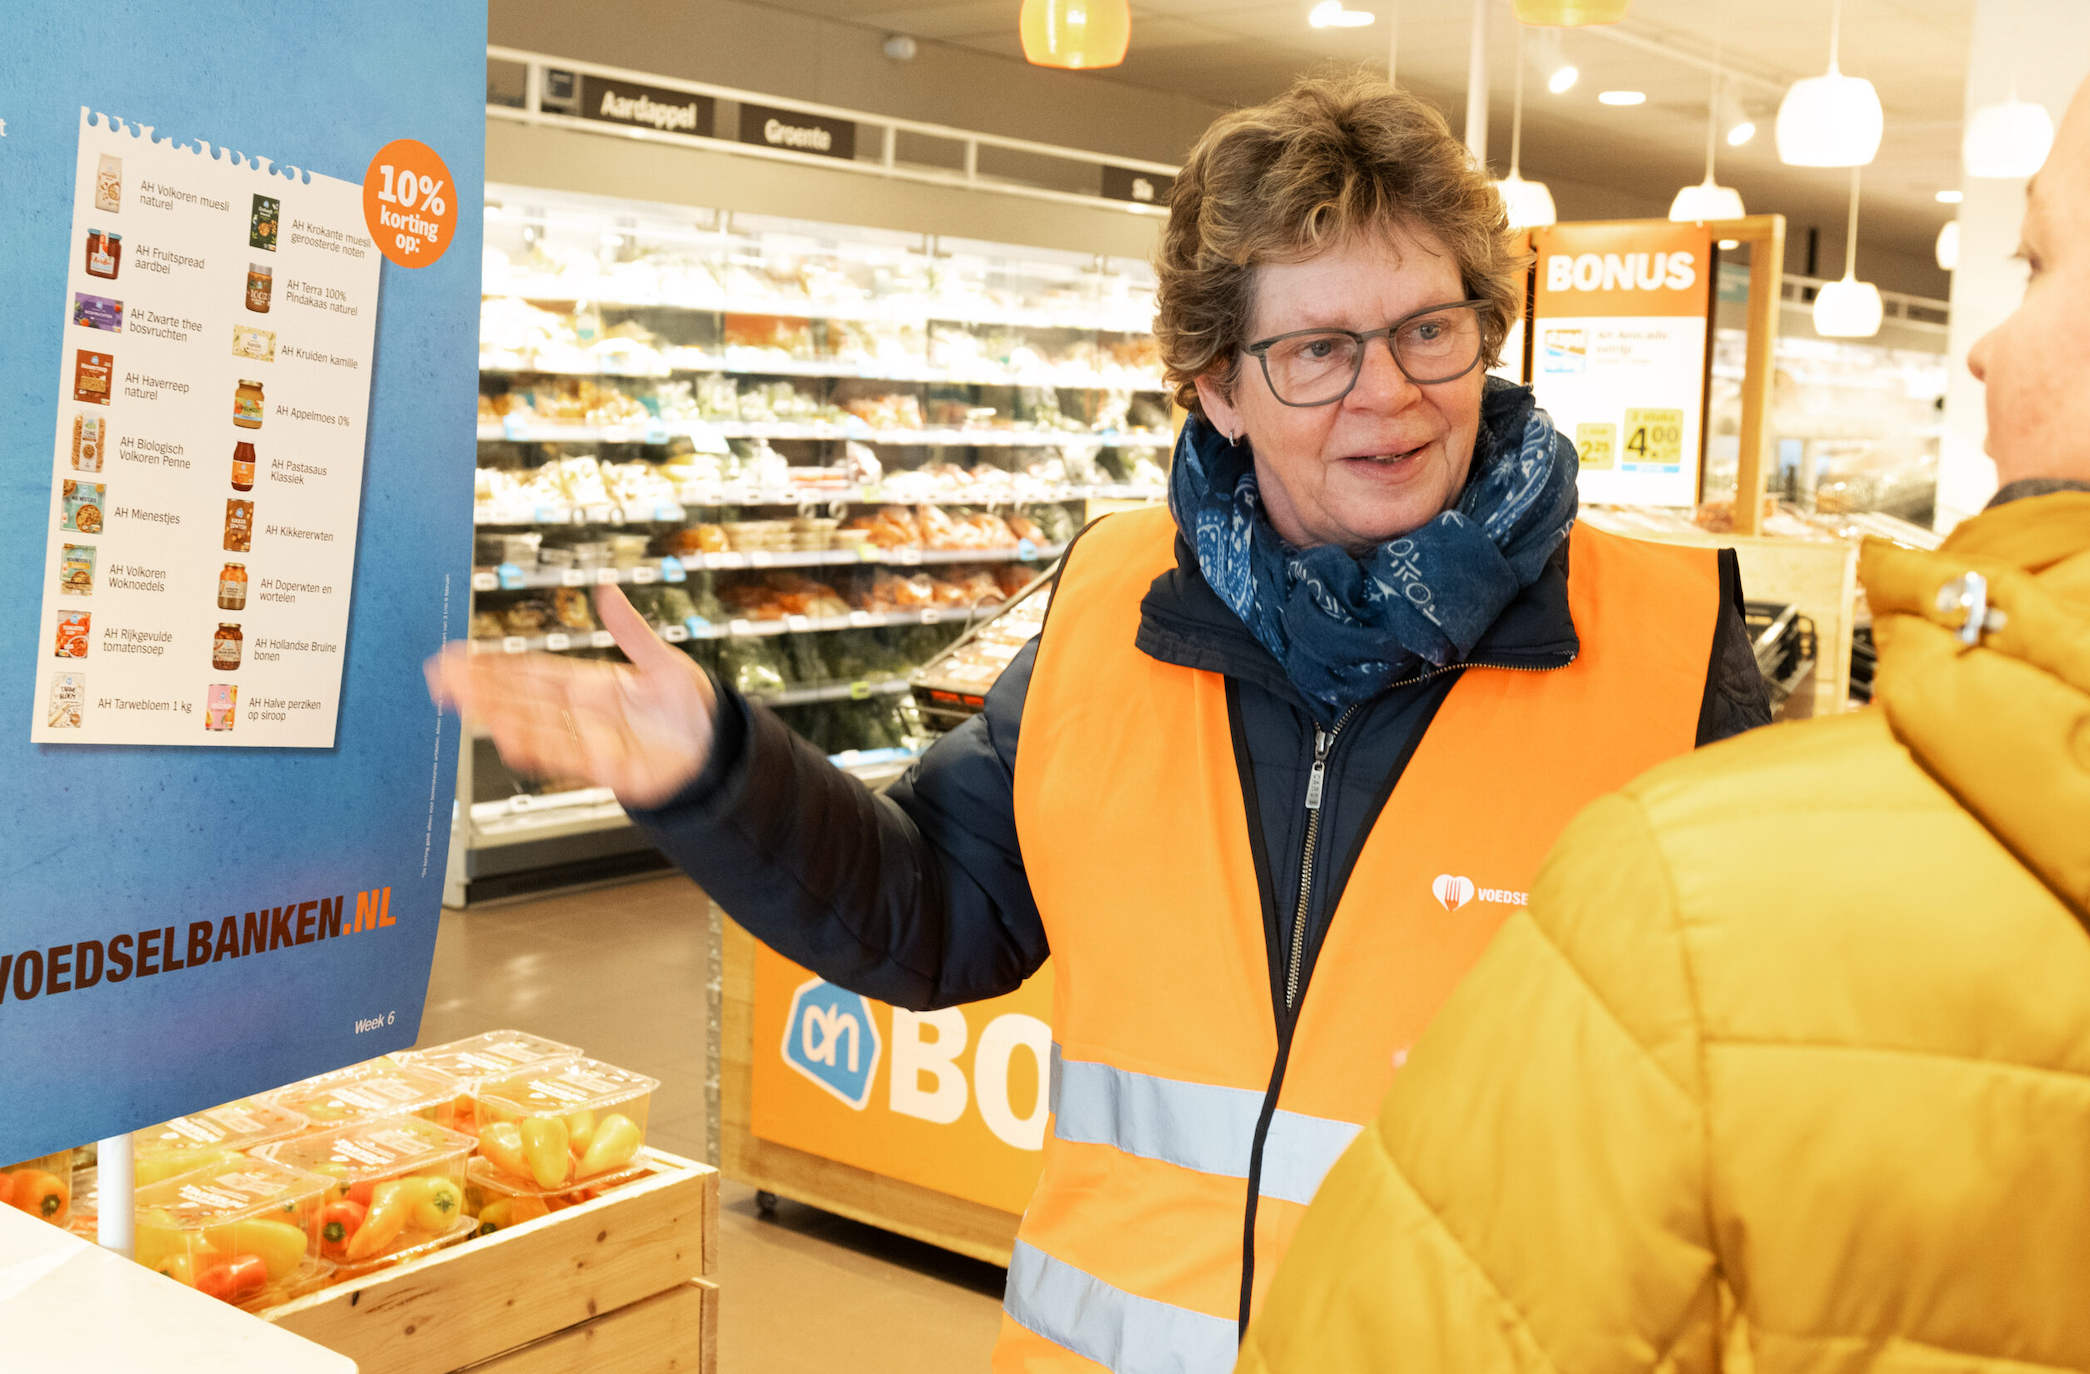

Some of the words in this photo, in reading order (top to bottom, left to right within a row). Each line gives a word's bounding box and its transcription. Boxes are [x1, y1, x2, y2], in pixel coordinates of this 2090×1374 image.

[600, 90, 697, 131] Aardappel
[764, 118, 832, 151] Groente
[141, 181, 154, 192] AH
[157, 184, 197, 204] Volkoren
[200, 196, 230, 212] muesli
[378, 165, 445, 216] 10%
[140, 195, 173, 211] naturel
[380, 204, 438, 242] korting
[292, 219, 304, 230] AH
[307, 223, 343, 242] Krokante
[346, 233, 371, 248] muesli
[291, 232, 340, 252] geroosterde
[342, 246, 365, 259] noten
[396, 234, 420, 254] op:
[136, 244, 150, 256] AH
[153, 248, 204, 269] Fruitspread
[135, 259, 170, 274] aardbei
[1547, 252, 1696, 292] BONUS
[287, 279, 299, 290] AH
[302, 282, 322, 296] Terra
[326, 288, 346, 301] 100%
[286, 291, 327, 310] Pindakaas
[330, 301, 357, 316] naturel
[131, 308, 144, 320] AH
[148, 312, 179, 327] Zwarte
[182, 318, 202, 332] thee
[130, 321, 187, 342] bosvruchten
[282, 345, 293, 356] AH
[296, 348, 327, 363] Kruiden
[330, 354, 358, 369] kamille
[126, 372, 138, 383] AH
[142, 375, 189, 394] Haverreep
[124, 386, 157, 400] naturel
[276, 405, 288, 416] AH
[291, 408, 335, 425] Appelmoes
[338, 416, 350, 426] 0%
[120, 436, 134, 447] AH
[138, 439, 184, 455] Biologisch
[120, 450, 159, 464] Volkoren
[163, 456, 191, 469] Penne
[272, 458, 283, 469] AH
[287, 460, 327, 476] Pastasaus
[271, 471, 304, 485] Klassiek
[115, 507, 128, 518] AH
[132, 509, 180, 525] Mienestjes
[265, 525, 277, 535] AH
[281, 526, 333, 542] Kikkererwten
[110, 564, 123, 575] AH
[127, 566, 166, 579] Volkoren
[109, 578, 165, 592] Woknoedels
[261, 578, 272, 589] AH
[276, 580, 319, 593] Doperwten
[322, 586, 332, 594] en
[260, 591, 295, 603] wortelen
[104, 628, 118, 639] AH
[121, 629, 172, 643] Rijkgevulde
[103, 642, 164, 656] tomatensoep
[255, 638, 267, 648] AH
[270, 639, 309, 651] Hollandse
[312, 642, 336, 653] Bruine
[254, 651, 280, 661] bonen
[98, 698, 111, 709] AH
[115, 699, 169, 711] Tarwebloem
[174, 701, 177, 711] 1
[182, 701, 192, 714] kg
[249, 698, 261, 708] AH
[264, 698, 285, 708] Halve
[288, 699, 321, 710] perziken
[248, 711, 258, 721] op
[262, 710, 286, 722] siroop
[355, 1014, 385, 1034] Week
[387, 1010, 396, 1025] 6
